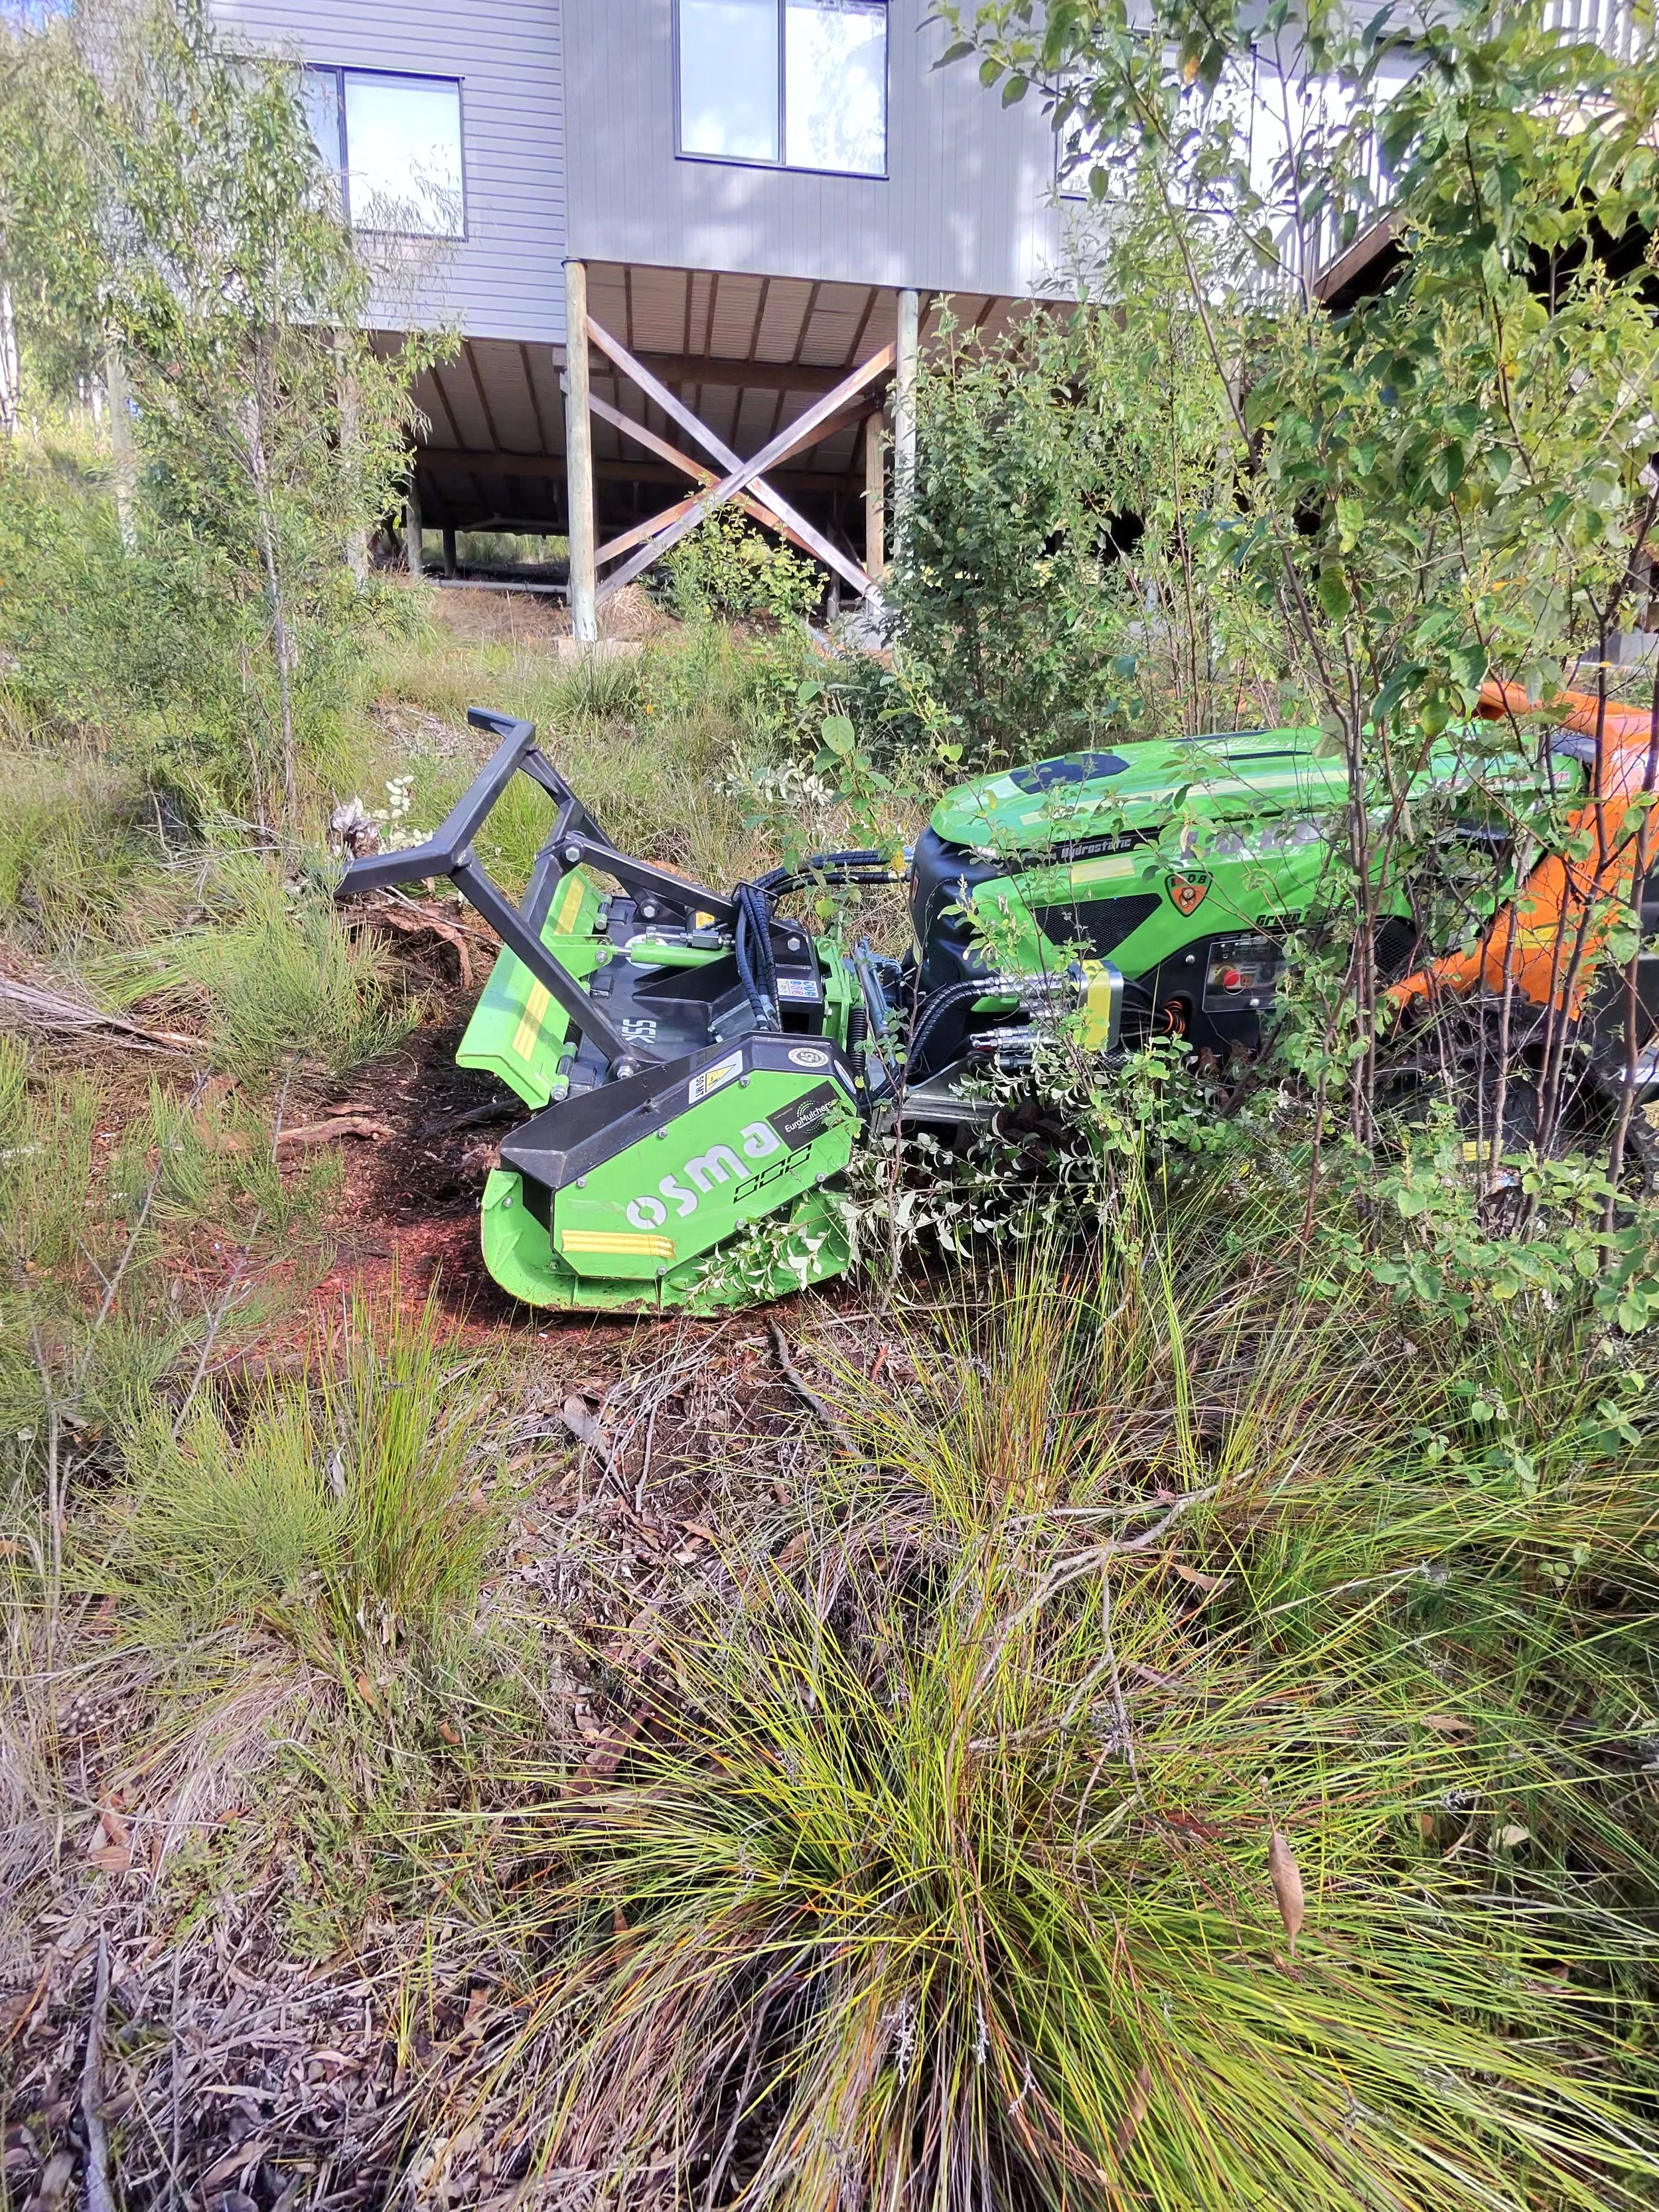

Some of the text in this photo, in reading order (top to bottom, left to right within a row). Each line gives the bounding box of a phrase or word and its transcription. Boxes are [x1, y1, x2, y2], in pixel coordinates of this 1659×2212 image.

[1060, 838, 1131, 859] Hydrostatic
[621, 1019, 657, 1044] SSK
[800, 1053, 814, 1062] 45
[695, 1076, 704, 1097] 50 MT
[784, 1101, 832, 1133] EuroMulchers
[626, 1121, 782, 1230] osma
